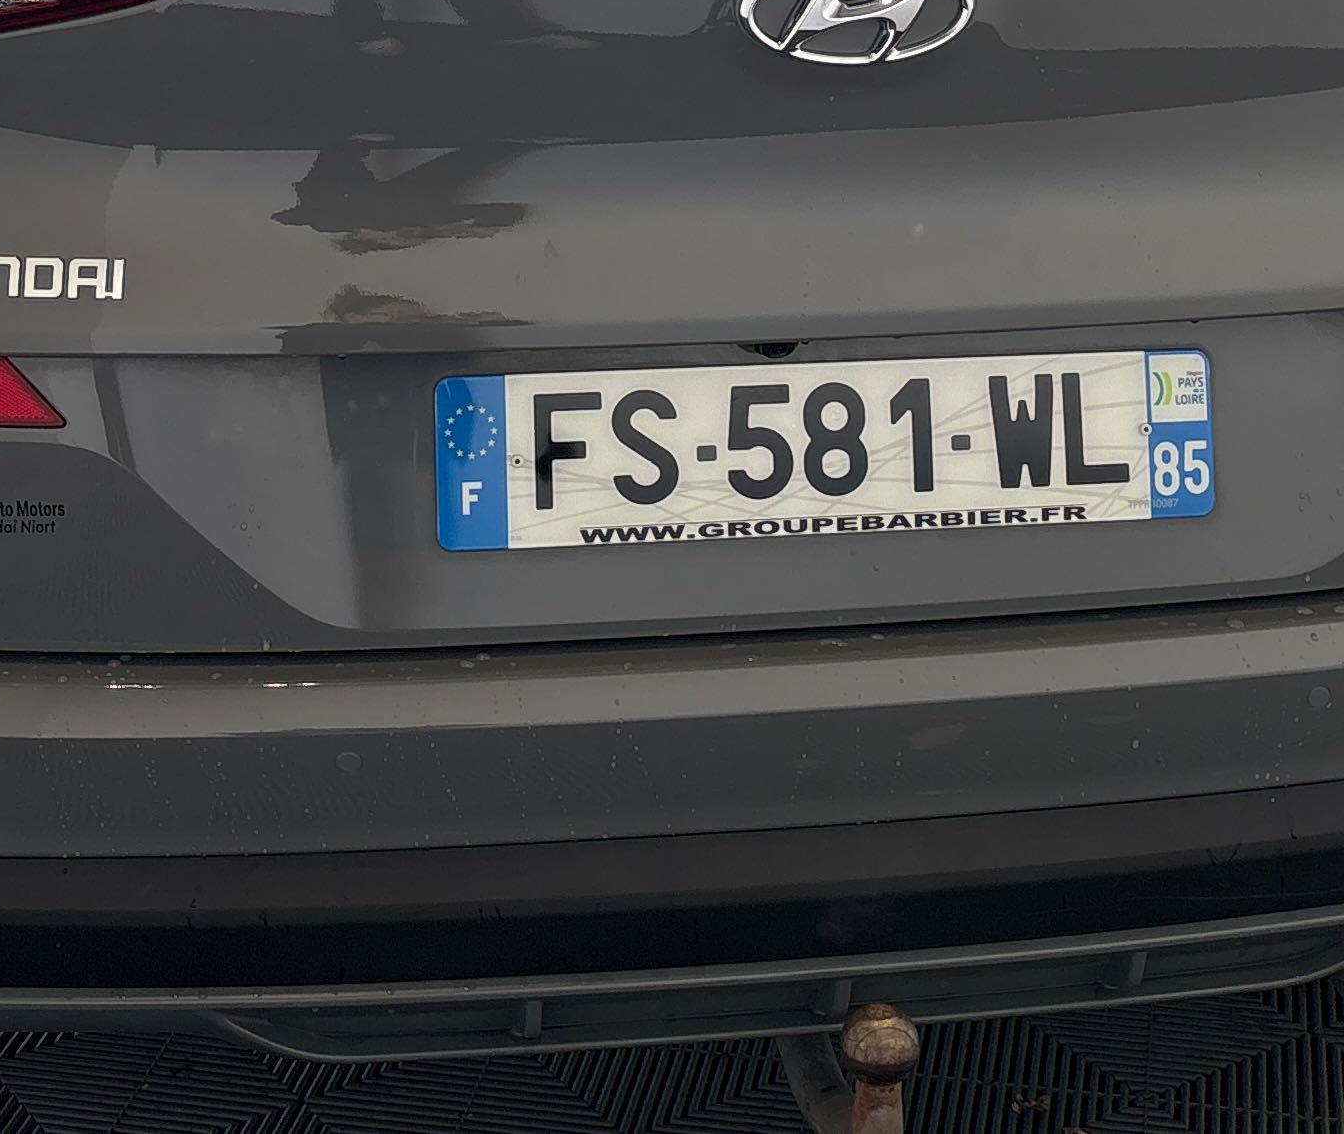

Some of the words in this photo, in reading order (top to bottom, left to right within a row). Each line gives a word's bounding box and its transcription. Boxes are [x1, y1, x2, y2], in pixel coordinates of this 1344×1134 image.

[1177, 376, 1204, 389] PAYS
[1174, 393, 1205, 406] LOIRE
[533, 371, 1131, 511] FS-581-WL
[1153, 439, 1211, 497] 85
[16, 499, 66, 518] Motors
[460, 481, 484, 516] F
[20, 519, 57, 534] Niort
[579, 504, 1089, 546] WWW.GROUPEBARBIER.FR
